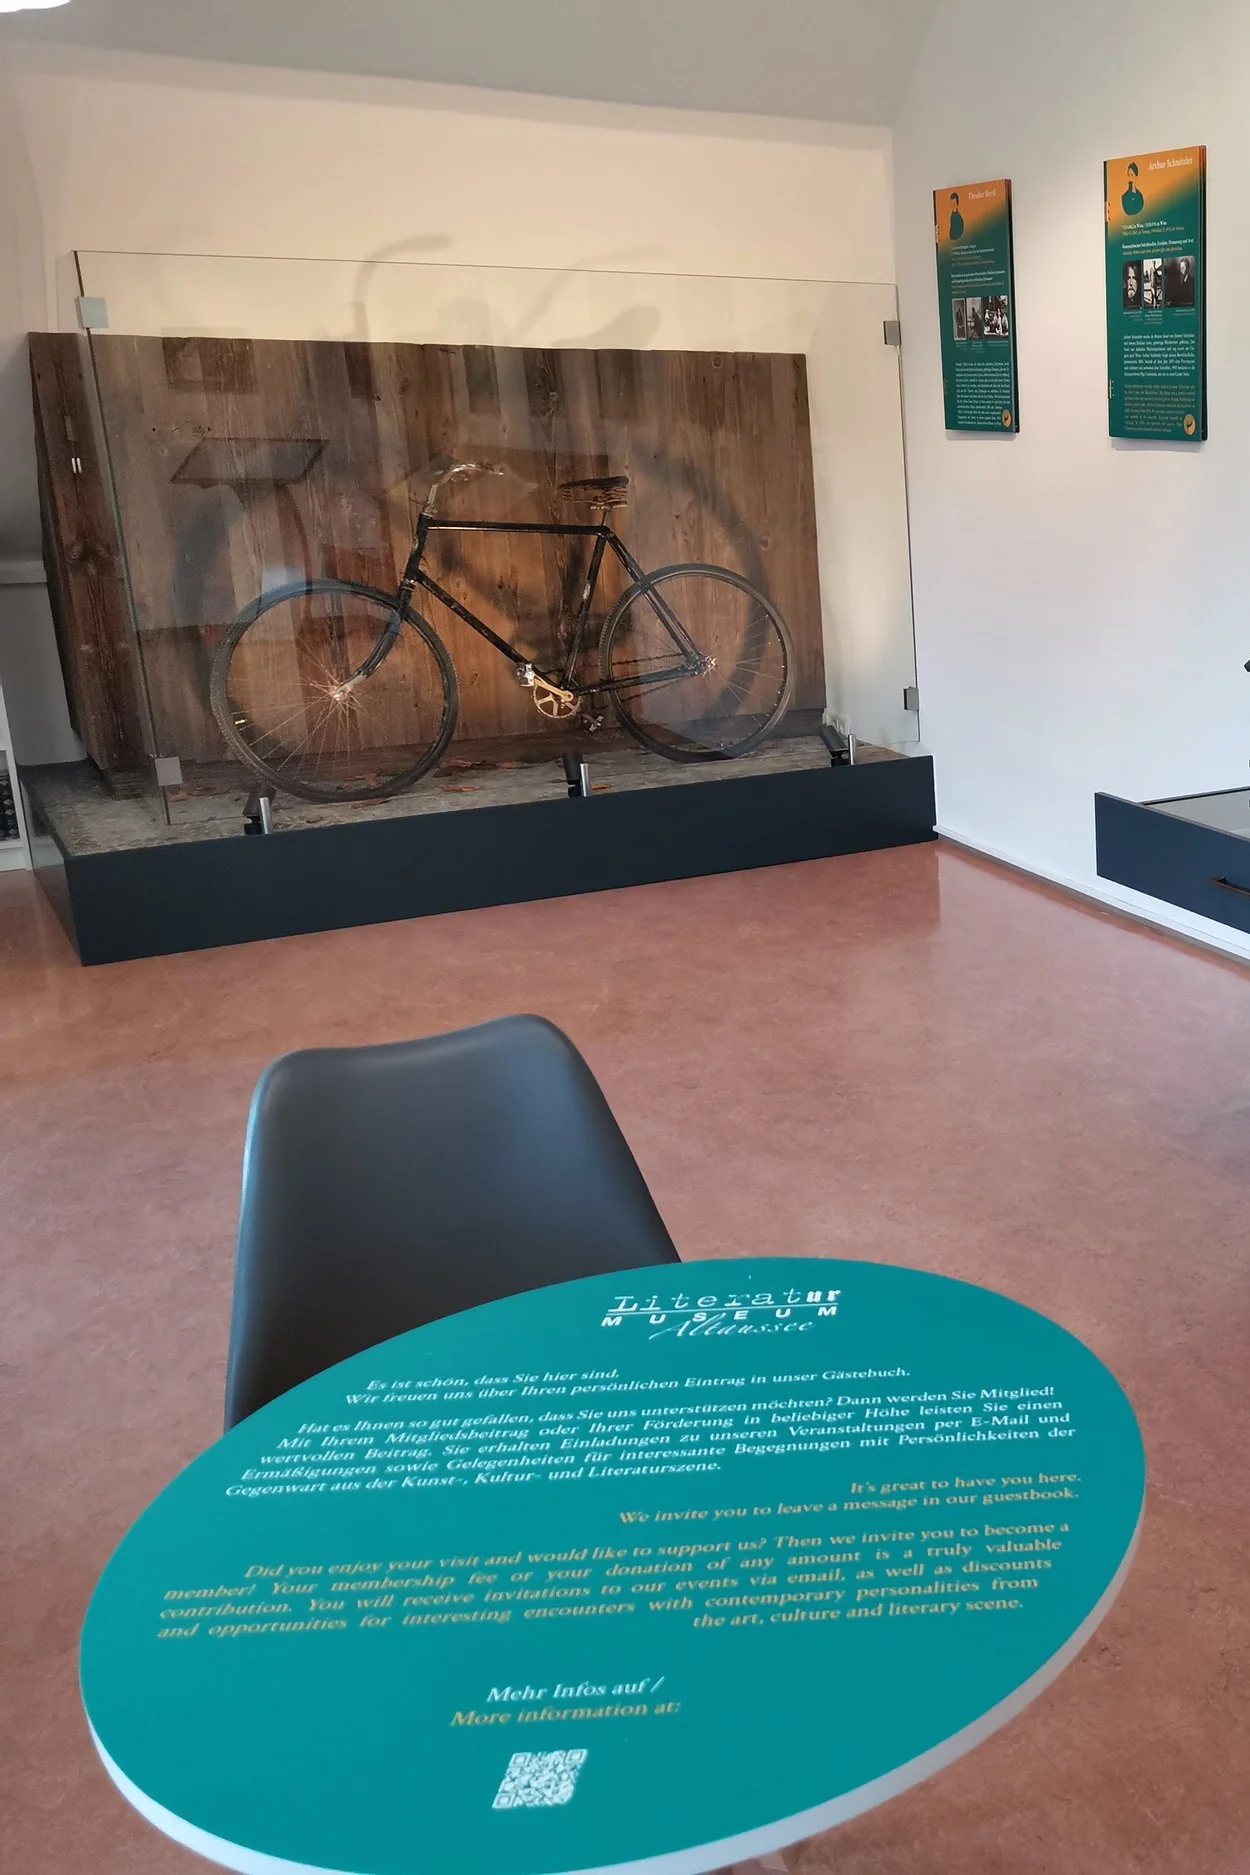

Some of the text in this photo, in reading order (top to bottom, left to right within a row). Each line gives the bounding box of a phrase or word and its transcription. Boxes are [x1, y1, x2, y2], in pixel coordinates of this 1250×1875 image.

[1148, 160, 1166, 170] Arthur
[608, 1288, 842, 1312] Literatur
[601, 1306, 837, 1326] MUSEUM
[648, 1312, 815, 1340] Altaussee
[346, 1367, 909, 1404] Wir freuen uns über Ihren persönlichen Eintrag in unser Gästebuch.
[366, 1368, 618, 1390] Es ist schön, dass Sie hier sind.
[277, 1397, 1062, 1448] Mit Ihrem Mitgliedsbeitrag oder Ihrer Förderung in beliebiger Höhe leisten Sie einen
[850, 1473, 1080, 1494] It's great to have you here.
[619, 1487, 1077, 1523] We invite you to leave a message in our guestbook.
[487, 1685, 546, 1701] Mehr
[553, 1681, 605, 1698] Infos
[611, 1678, 649, 1694] auf
[451, 1701, 680, 1726] More information at:
